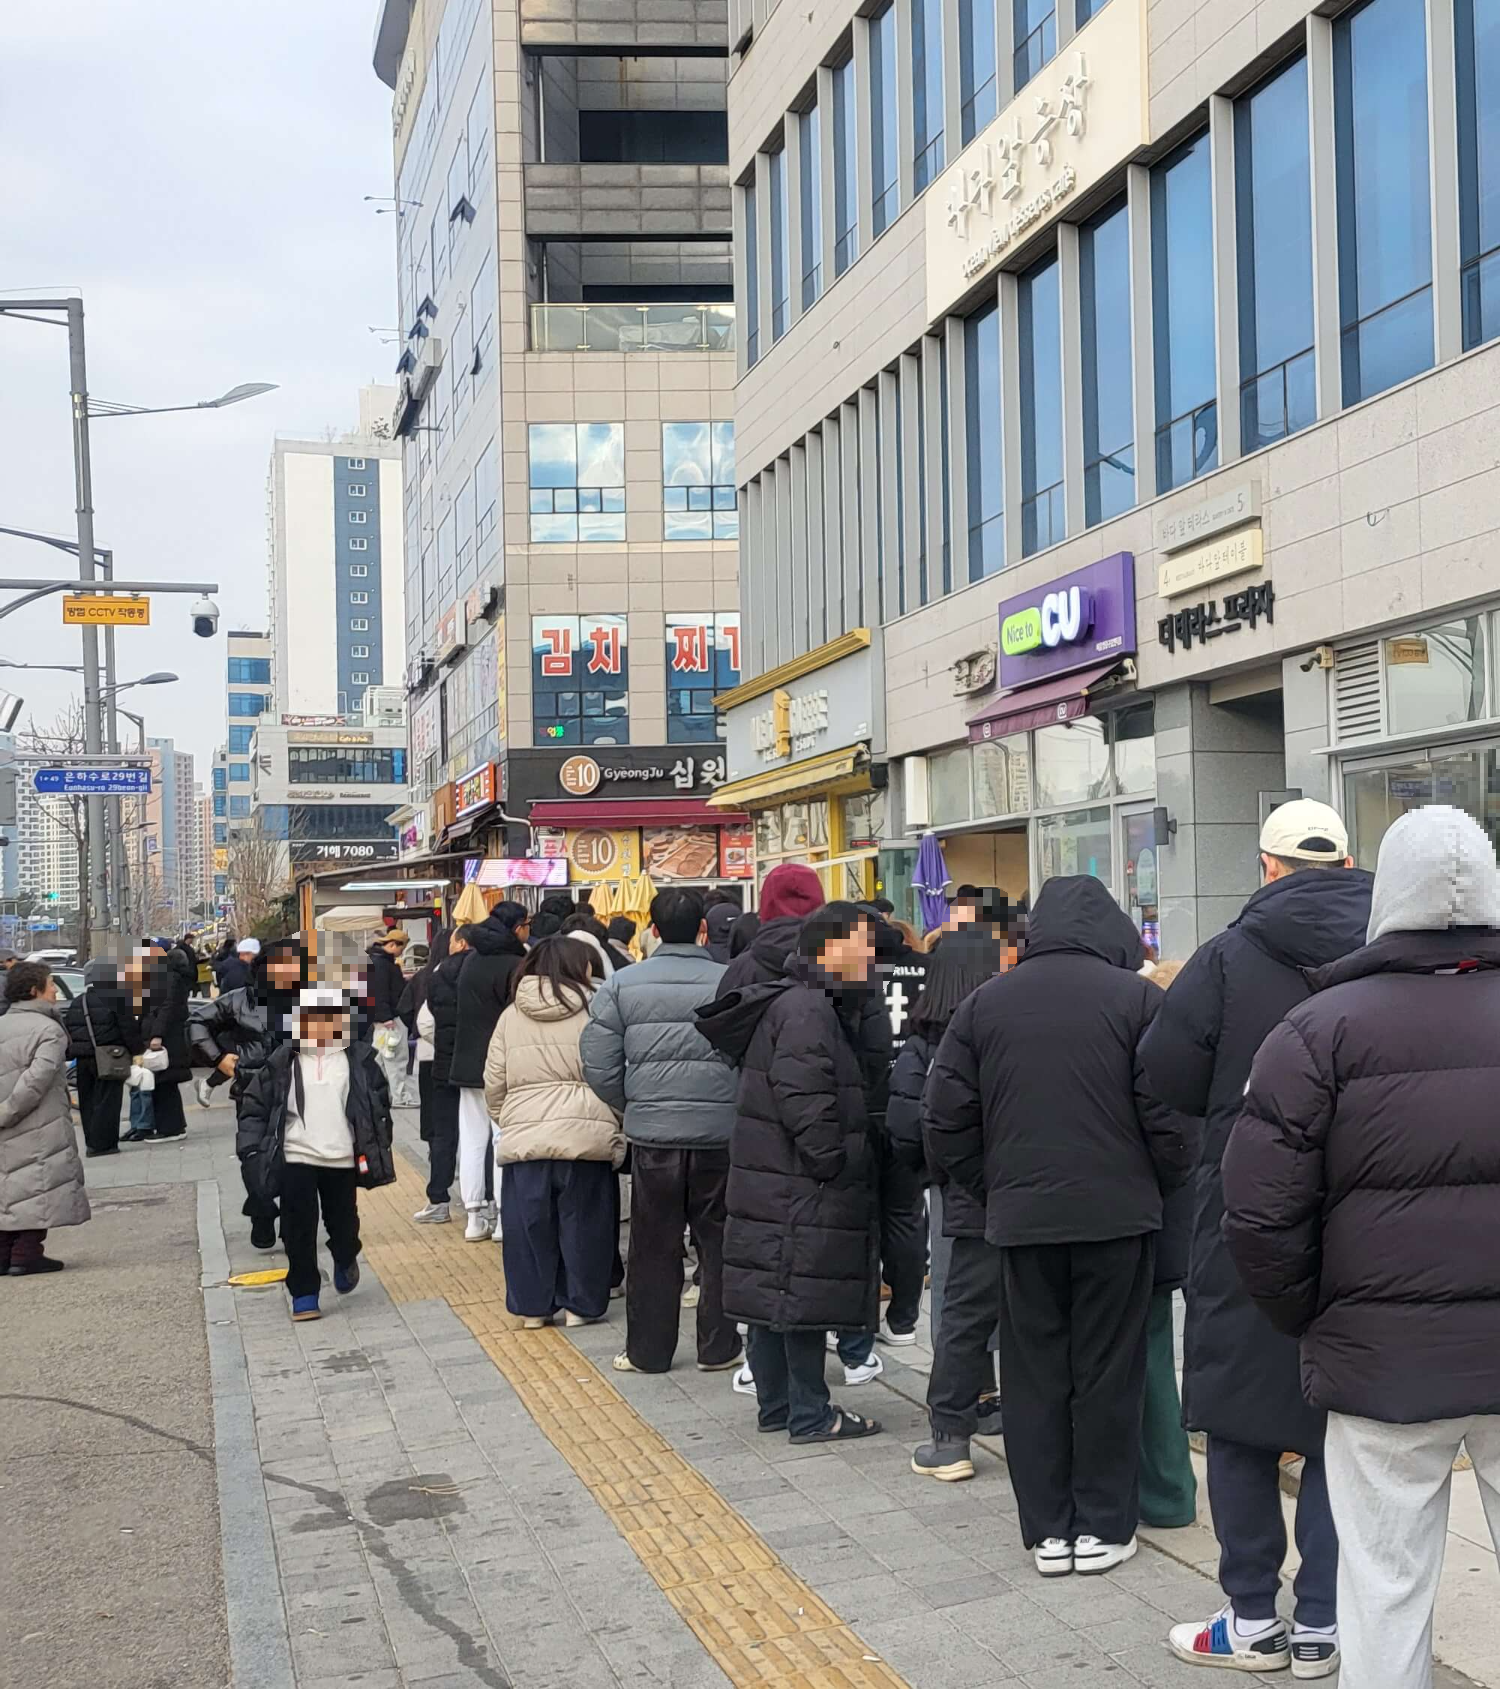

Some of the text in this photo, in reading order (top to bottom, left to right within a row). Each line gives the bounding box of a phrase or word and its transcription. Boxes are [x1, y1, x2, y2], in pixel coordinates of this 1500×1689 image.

[88, 607, 116, 617] CCTV
[1007, 624, 1024, 645] Nice
[1025, 621, 1033, 639] to
[1041, 586, 1081, 647] CU
[578, 763, 596, 787] 10
[604, 767, 664, 781] GyeongJu
[342, 845, 375, 857] 7080
[592, 837, 613, 865] 10
